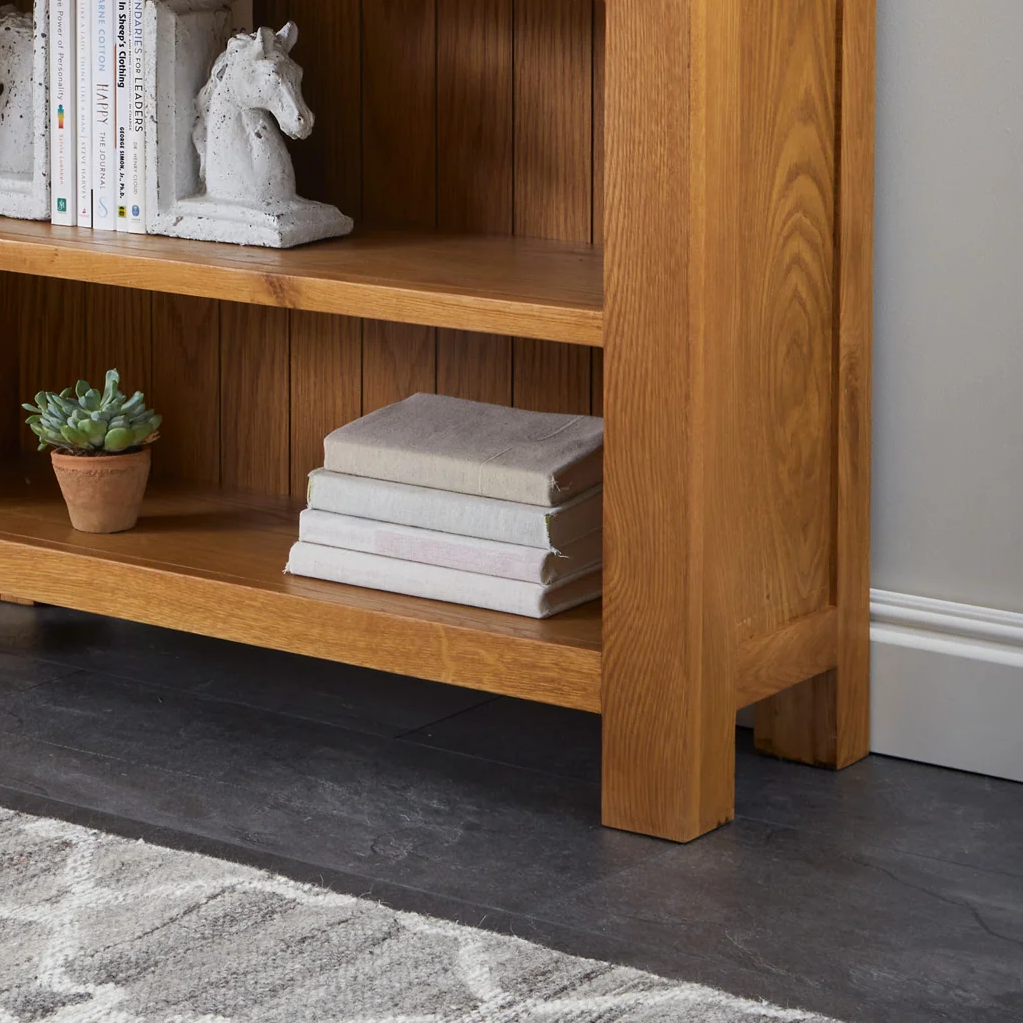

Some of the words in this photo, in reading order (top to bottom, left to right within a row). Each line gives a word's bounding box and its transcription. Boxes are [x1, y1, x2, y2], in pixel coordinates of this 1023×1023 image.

[119, 1, 127, 11] In
[57, 40, 64, 49] of
[98, 29, 106, 72] COTTON
[117, 14, 127, 48] Sheep's
[57, 52, 65, 101] Personality
[117, 51, 127, 88] Clothing
[96, 83, 109, 126] HAPPY
[134, 77, 143, 132] LEADERS
